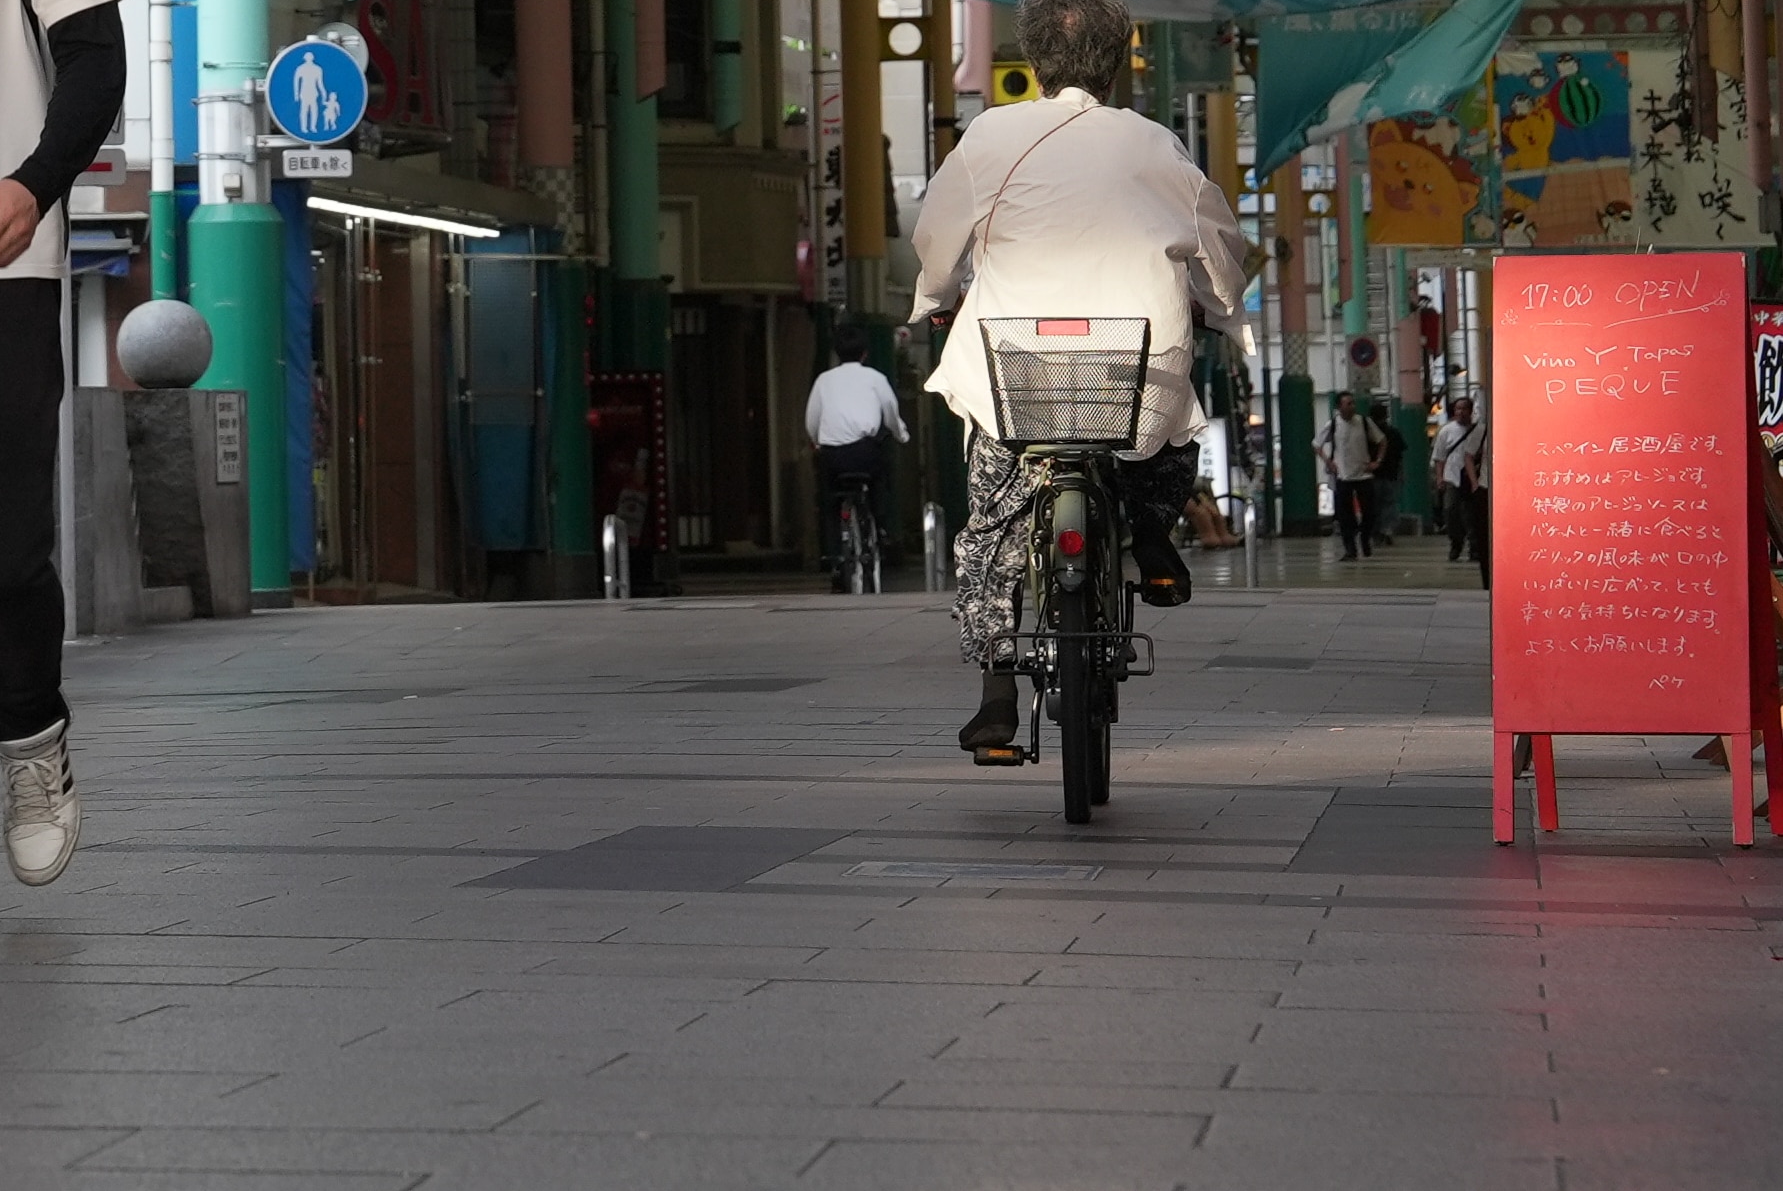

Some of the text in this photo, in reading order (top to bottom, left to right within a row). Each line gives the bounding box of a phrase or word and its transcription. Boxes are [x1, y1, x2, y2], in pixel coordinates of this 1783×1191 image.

[1520, 270, 1700, 312] 17:00 OPEN
[1626, 344, 1695, 364] Tapas
[1544, 370, 1682, 405] PEQUE
